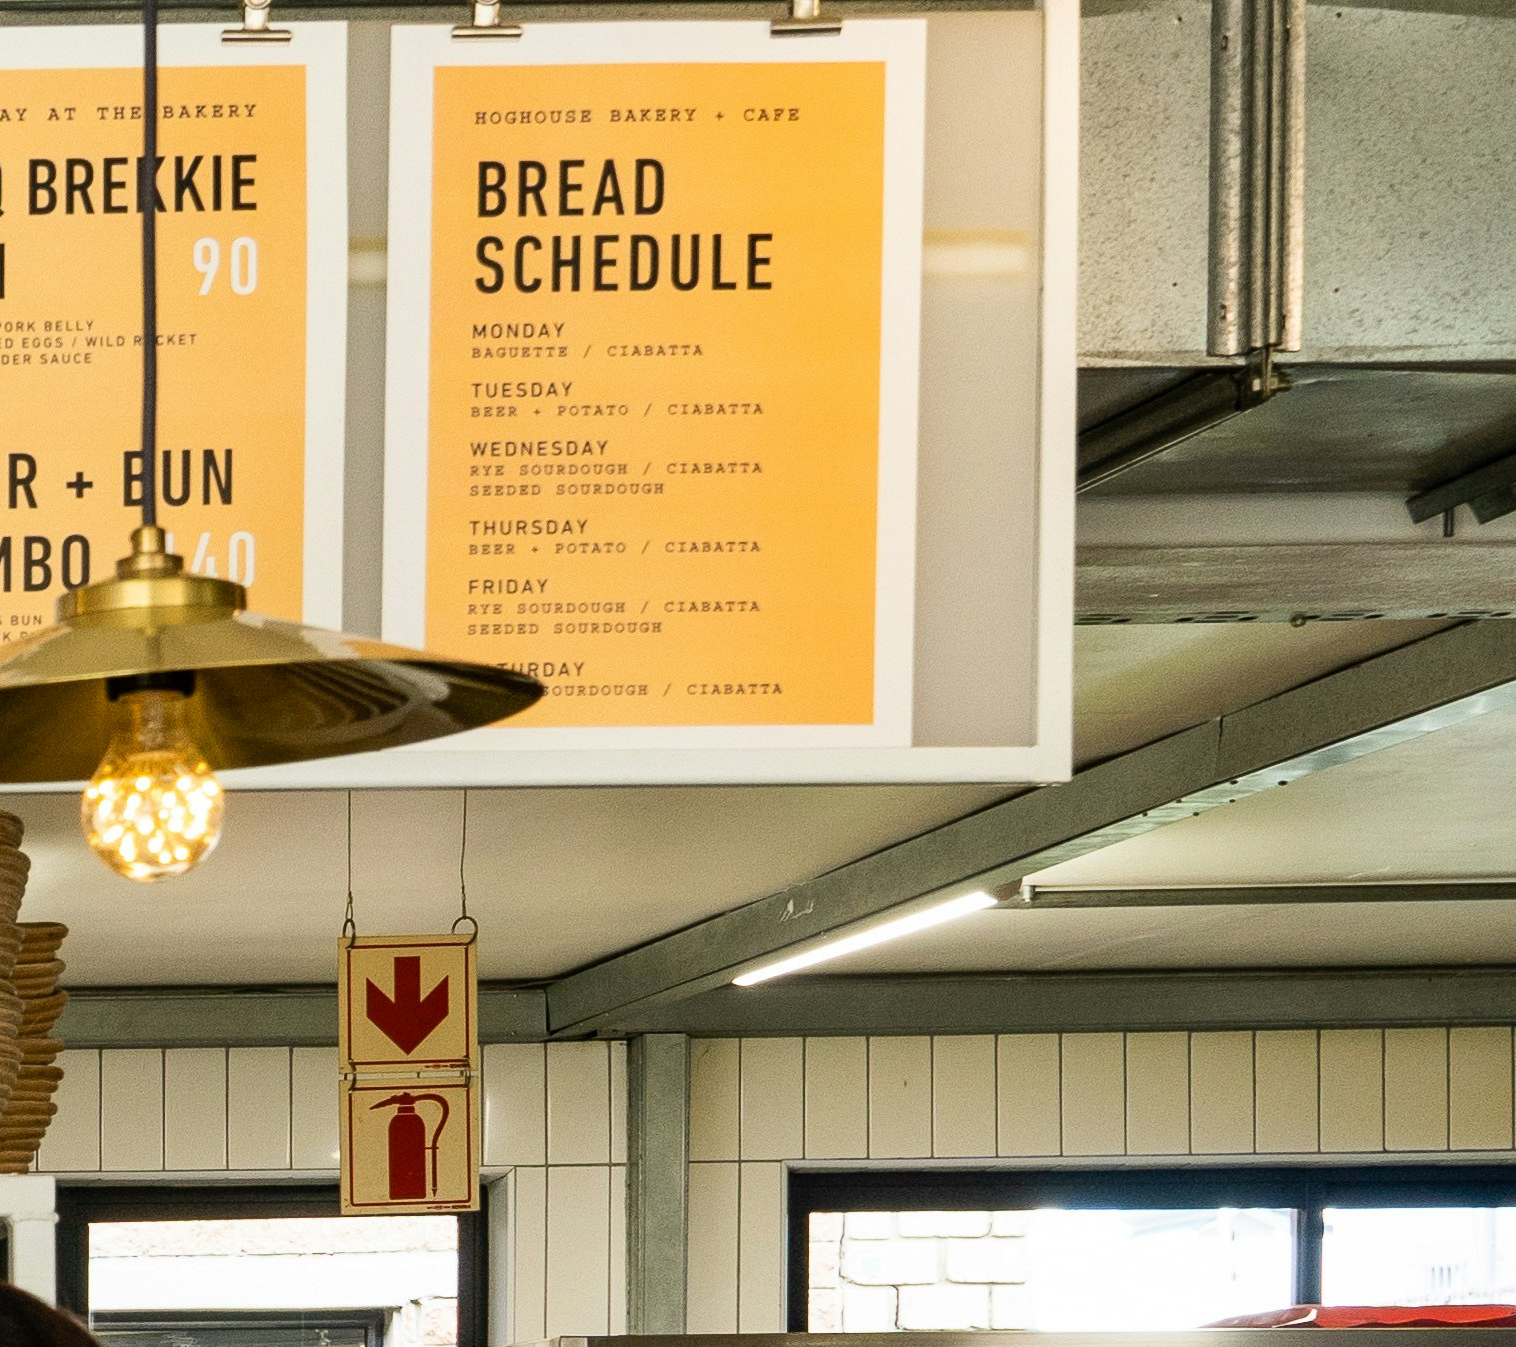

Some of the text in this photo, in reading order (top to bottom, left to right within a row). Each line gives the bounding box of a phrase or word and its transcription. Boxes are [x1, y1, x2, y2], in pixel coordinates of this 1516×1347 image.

[48, 107, 76, 121] AT
[97, 105, 142, 120] THE
[162, 104, 257, 119] BAKERY
[475, 109, 591, 125] HOGHOUSE
[610, 108, 696, 122] BAKERY
[743, 108, 799, 122] CAFE
[478, 158, 664, 217] BREAD
[193, 236, 258, 296] 90
[475, 233, 773, 294] SCHEDULE
[473, 323, 564, 339] MONDAY
[40, 352, 91, 365] SAUCE
[471, 382, 572, 398] TUESDAY
[470, 440, 608, 457] WEDNESDAY
[470, 483, 664, 496] SEEDED SOURDOUGH
[469, 519, 588, 536] THURSDAY
[469, 579, 547, 594] FRIDAY
